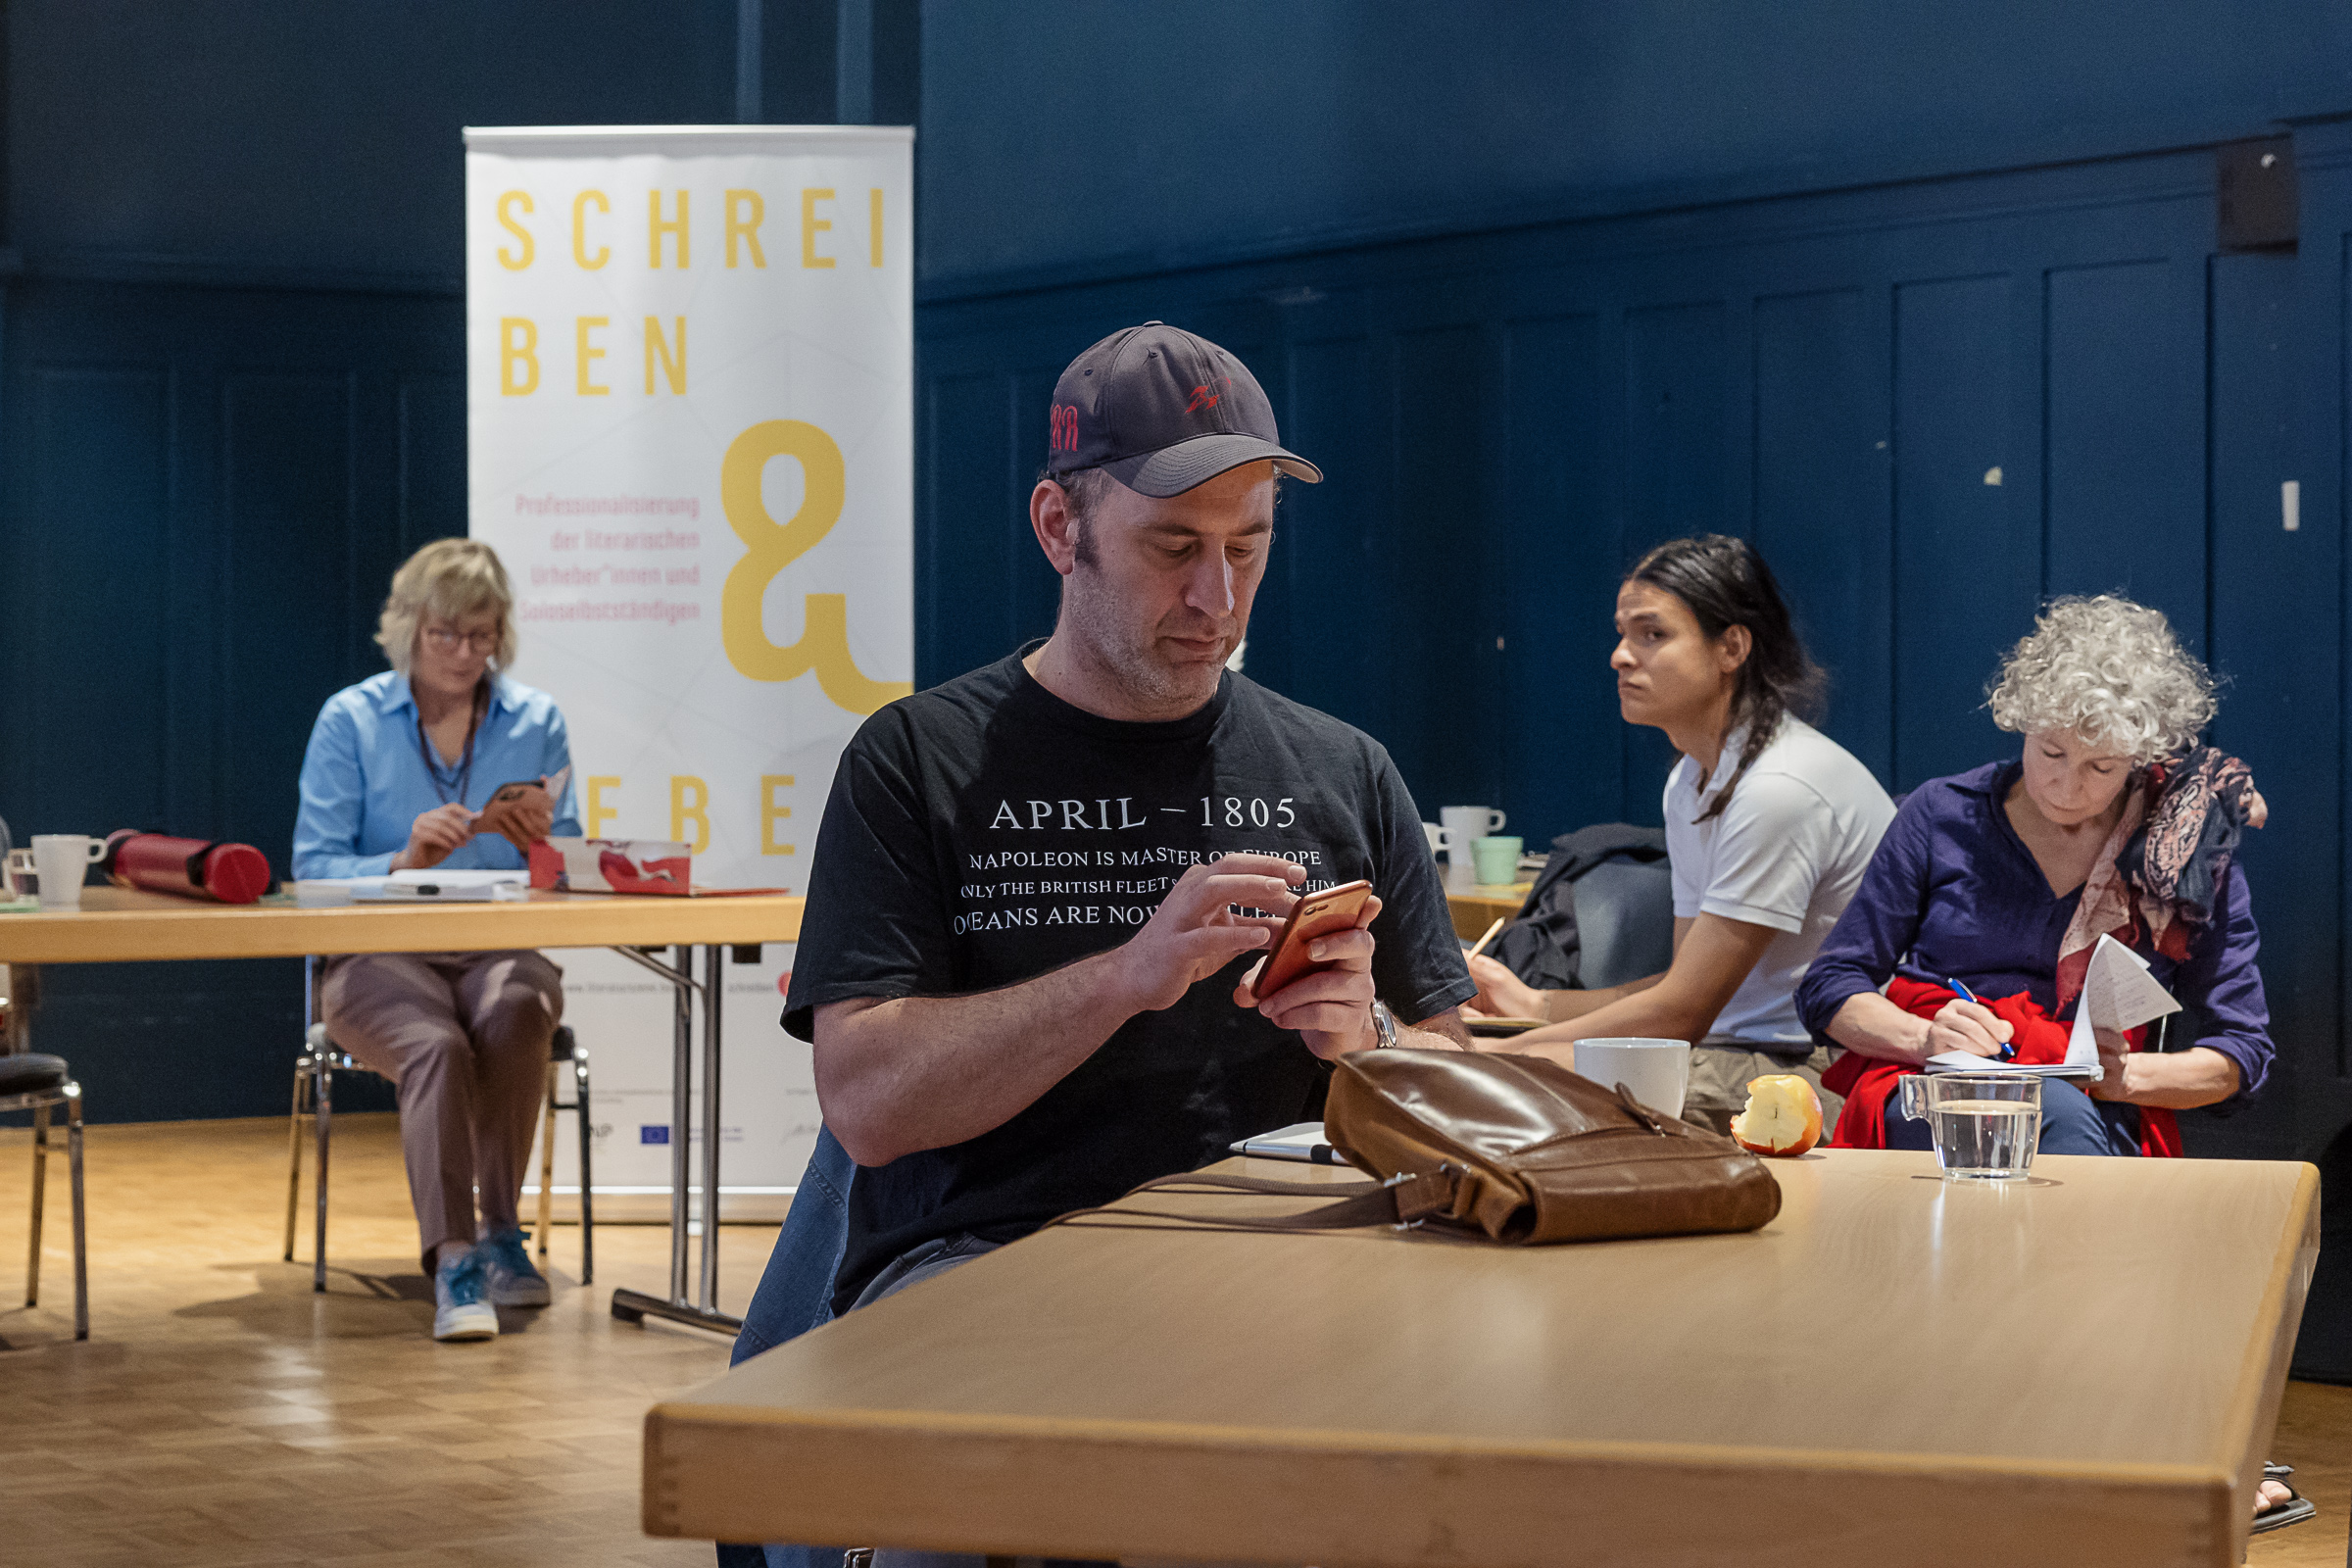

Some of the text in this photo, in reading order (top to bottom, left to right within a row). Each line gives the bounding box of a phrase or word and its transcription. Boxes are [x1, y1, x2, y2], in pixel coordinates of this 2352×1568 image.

[500, 316, 688, 396] BEN
[989, 797, 1147, 831] APRIL
[1200, 797, 1297, 828] 1805
[969, 847, 1321, 870] NAPOLEON IS MASTER O OPE
[1000, 882, 1035, 896] THE
[1040, 880, 1112, 894] BRITISH
[1116, 876, 1169, 894] FLEET
[1305, 879, 1336, 892] HIM
[1045, 906, 1101, 924] ARE
